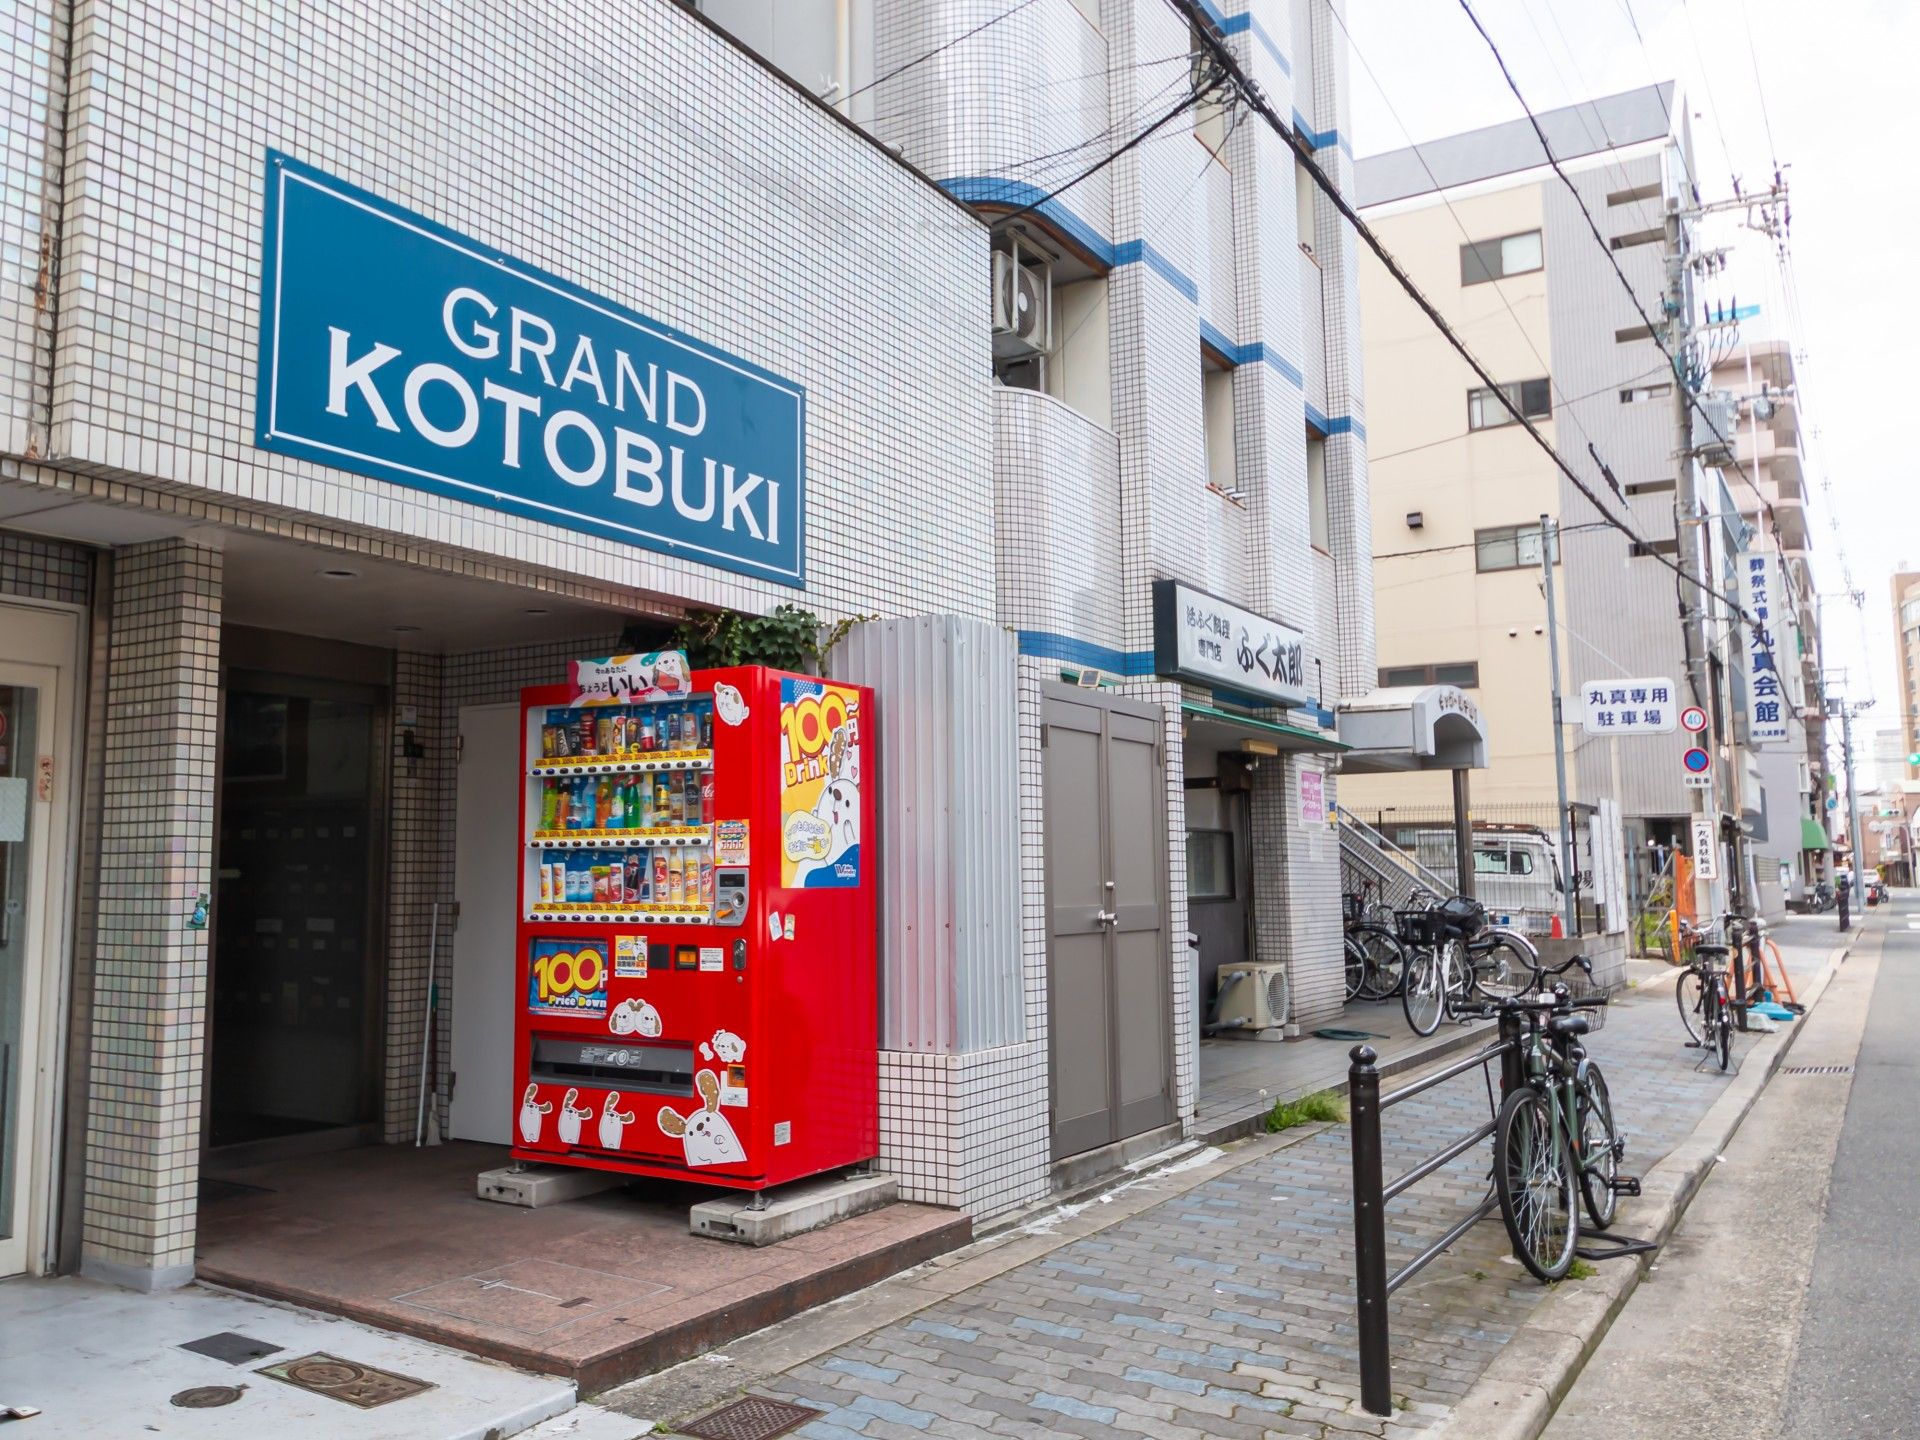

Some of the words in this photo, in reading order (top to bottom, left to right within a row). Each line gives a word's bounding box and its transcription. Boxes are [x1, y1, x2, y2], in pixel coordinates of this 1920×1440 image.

[442, 287, 707, 437] GRAND
[325, 326, 780, 545] KOTOBUKI
[1198, 639, 1222, 662] 専門店
[1236, 625, 1303, 688] ふぐ太郎
[1589, 687, 1668, 706] 丸真専用
[1597, 709, 1662, 727] 駐車場
[1686, 713, 1702, 725] 40
[784, 754, 830, 788] Drink
[548, 994, 577, 1008] Price
[577, 996, 607, 1010] Down
